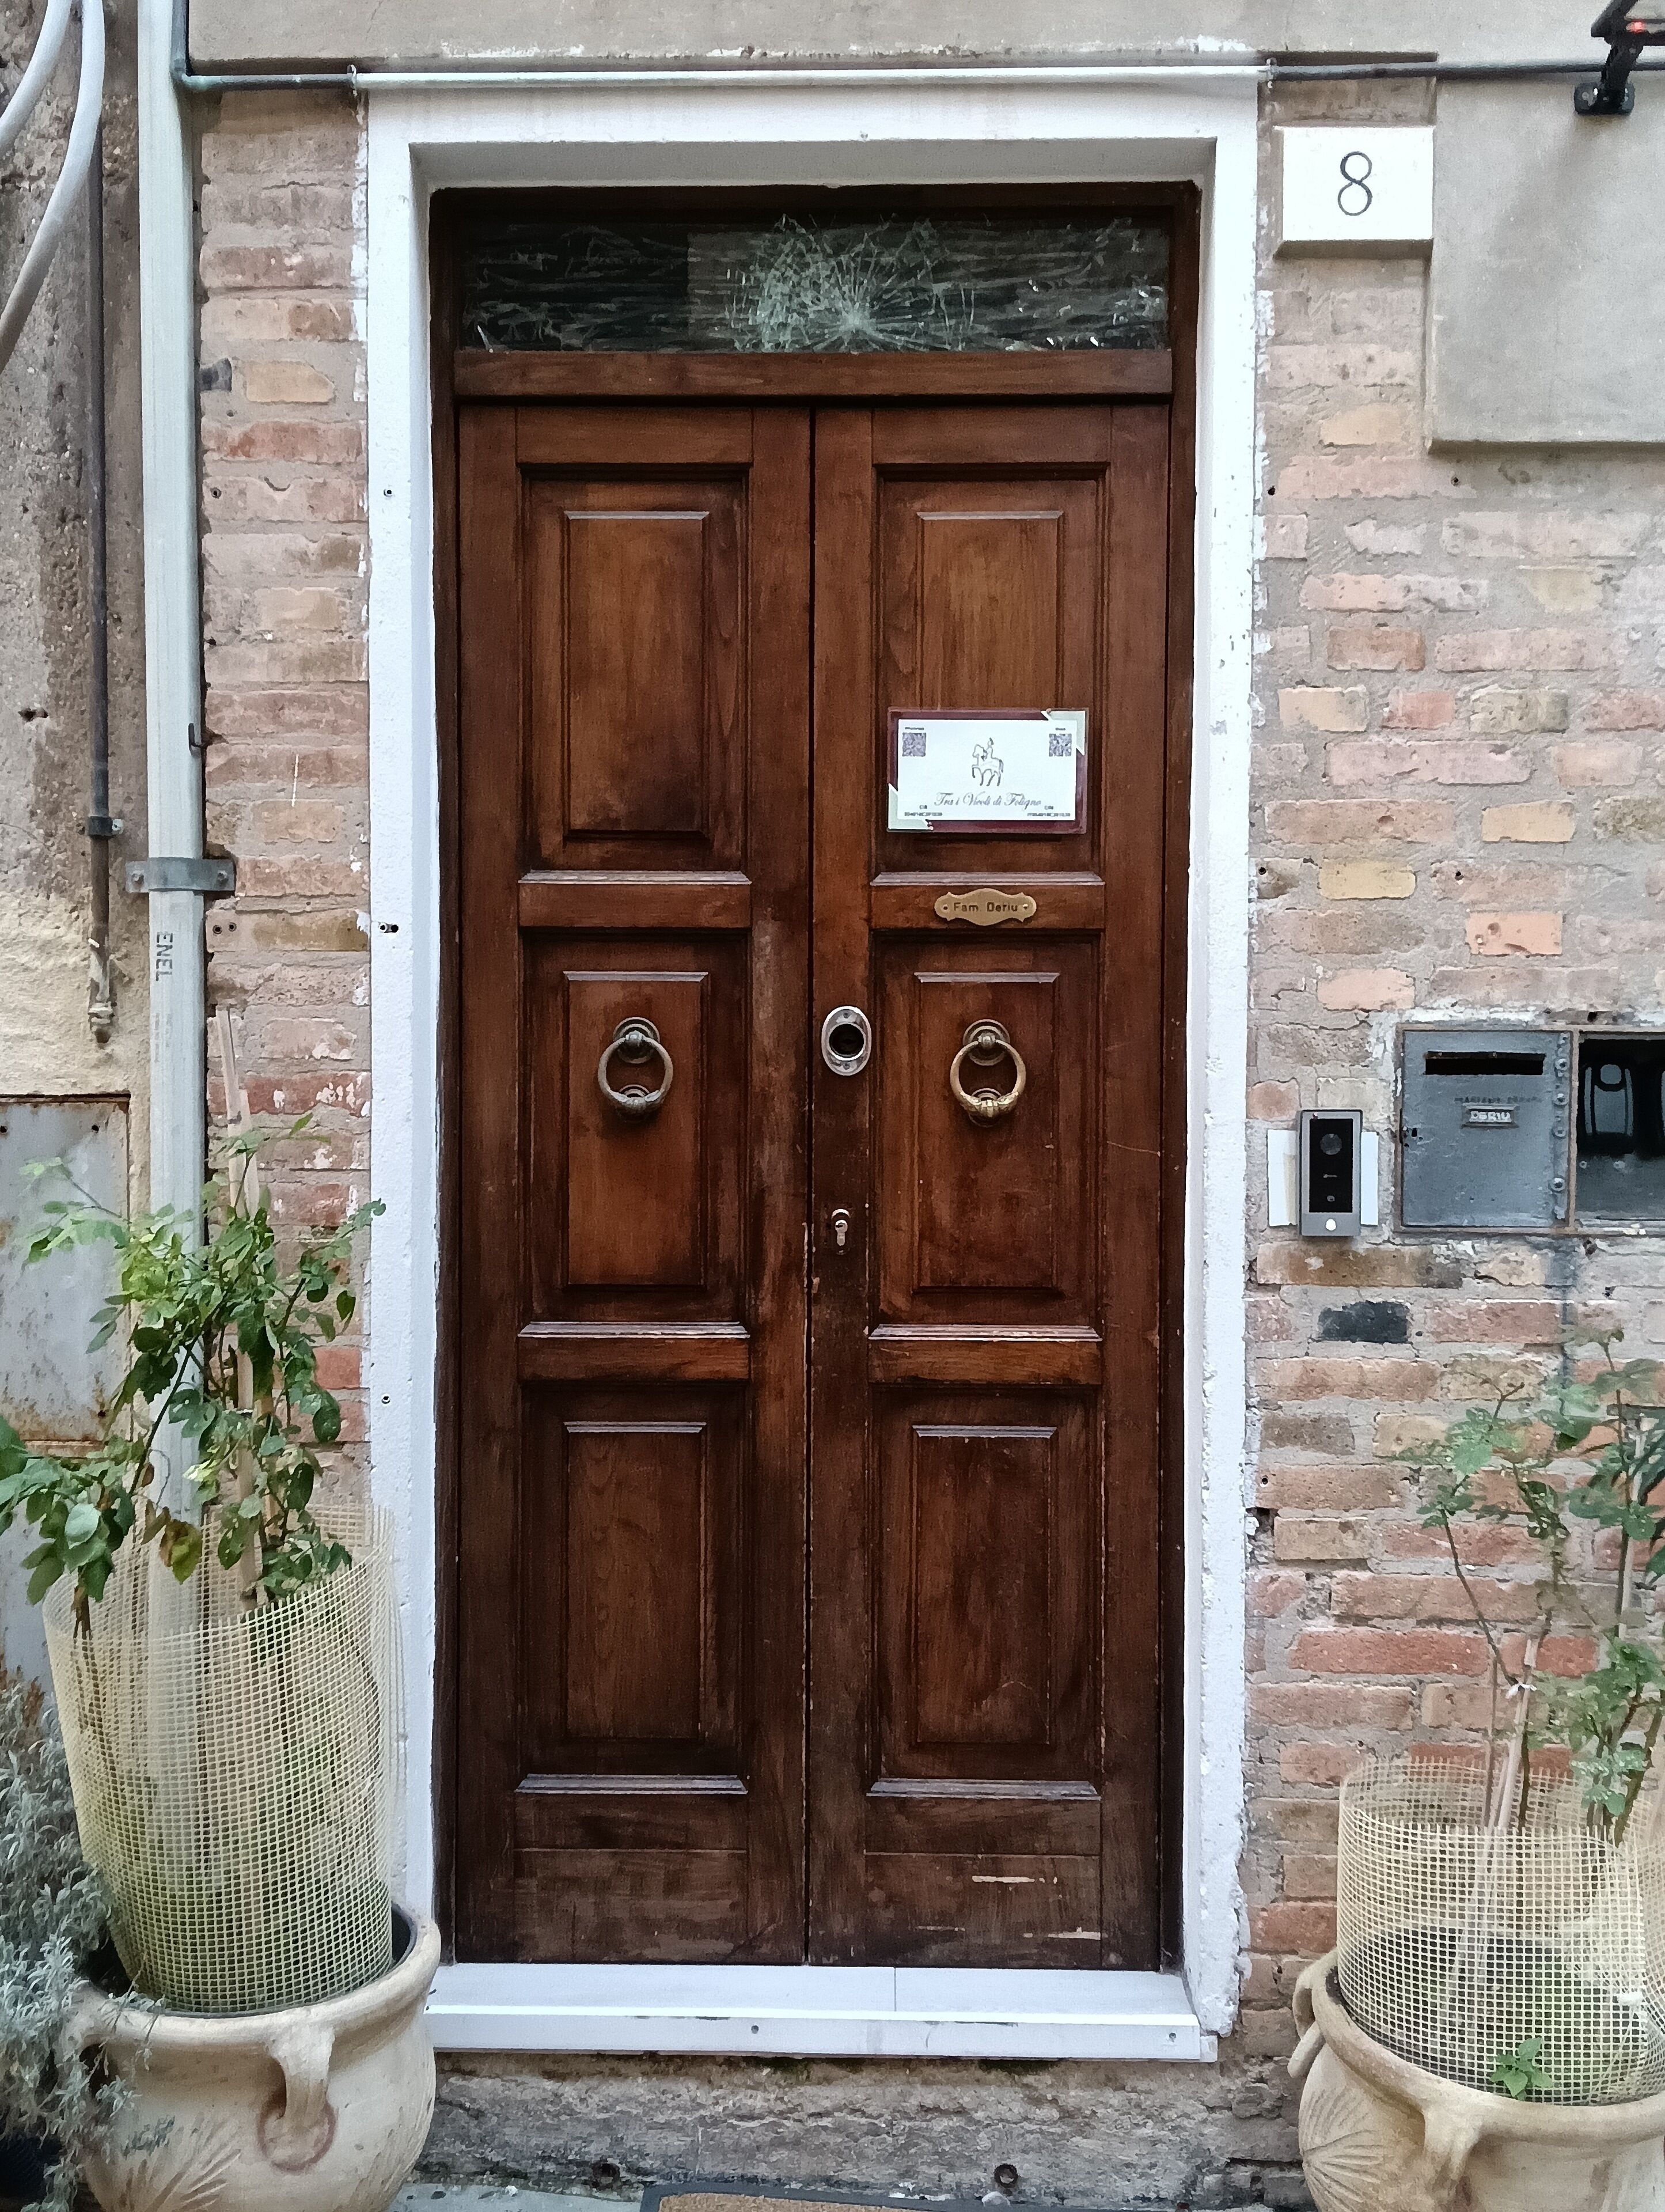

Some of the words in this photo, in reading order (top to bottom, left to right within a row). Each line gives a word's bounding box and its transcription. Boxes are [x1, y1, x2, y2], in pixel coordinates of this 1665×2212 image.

[1337, 150, 1373, 217] 8
[934, 791, 954, 806] Tra
[1004, 792, 1042, 811] Foligno
[987, 902, 1018, 912] Deriu
[155, 931, 173, 982] ENEL
